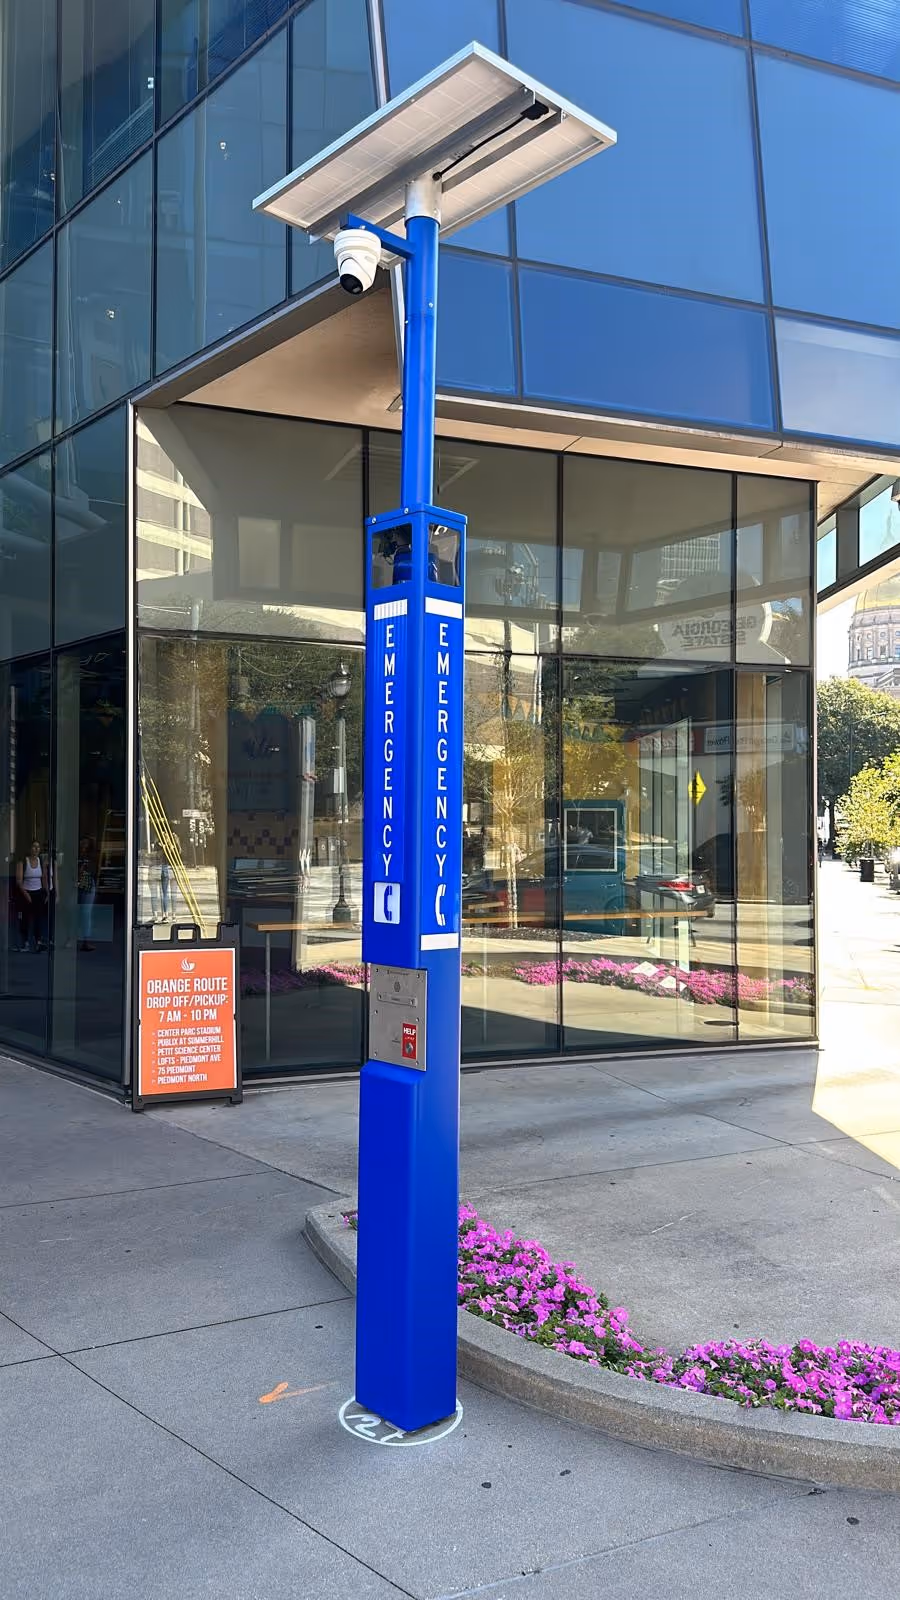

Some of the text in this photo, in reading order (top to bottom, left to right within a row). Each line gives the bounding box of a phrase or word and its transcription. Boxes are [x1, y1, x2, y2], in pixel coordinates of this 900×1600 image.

[382, 624, 396, 877] EMERGENCY
[435, 622, 450, 877] EMERGENCY
[147, 977, 228, 994] ORANGE ROUTE
[146, 994, 229, 1009] DROP OFF/PICKUP:
[159, 1011, 165, 1022] 7
[166, 1010, 182, 1022] AM
[191, 1009, 202, 1021] 10
[203, 1008, 217, 1021] PM
[158, 1026, 221, 1037] CENTER PARC STADIUM
[403, 1027, 416, 1036] HELP
[158, 1035, 224, 1047] PUBLIX AT SUMMERHILL
[158, 1044, 221, 1056] PETIT SCIENCE CENTER
[158, 1056, 176, 1065] LOFTS
[180, 1054, 209, 1063] PIEDMONT
[210, 1053, 221, 1062] AVE
[158, 1065, 196, 1075] 75 PIEDMONT
[158, 1073, 208, 1084] PIEDMONT NORTH
